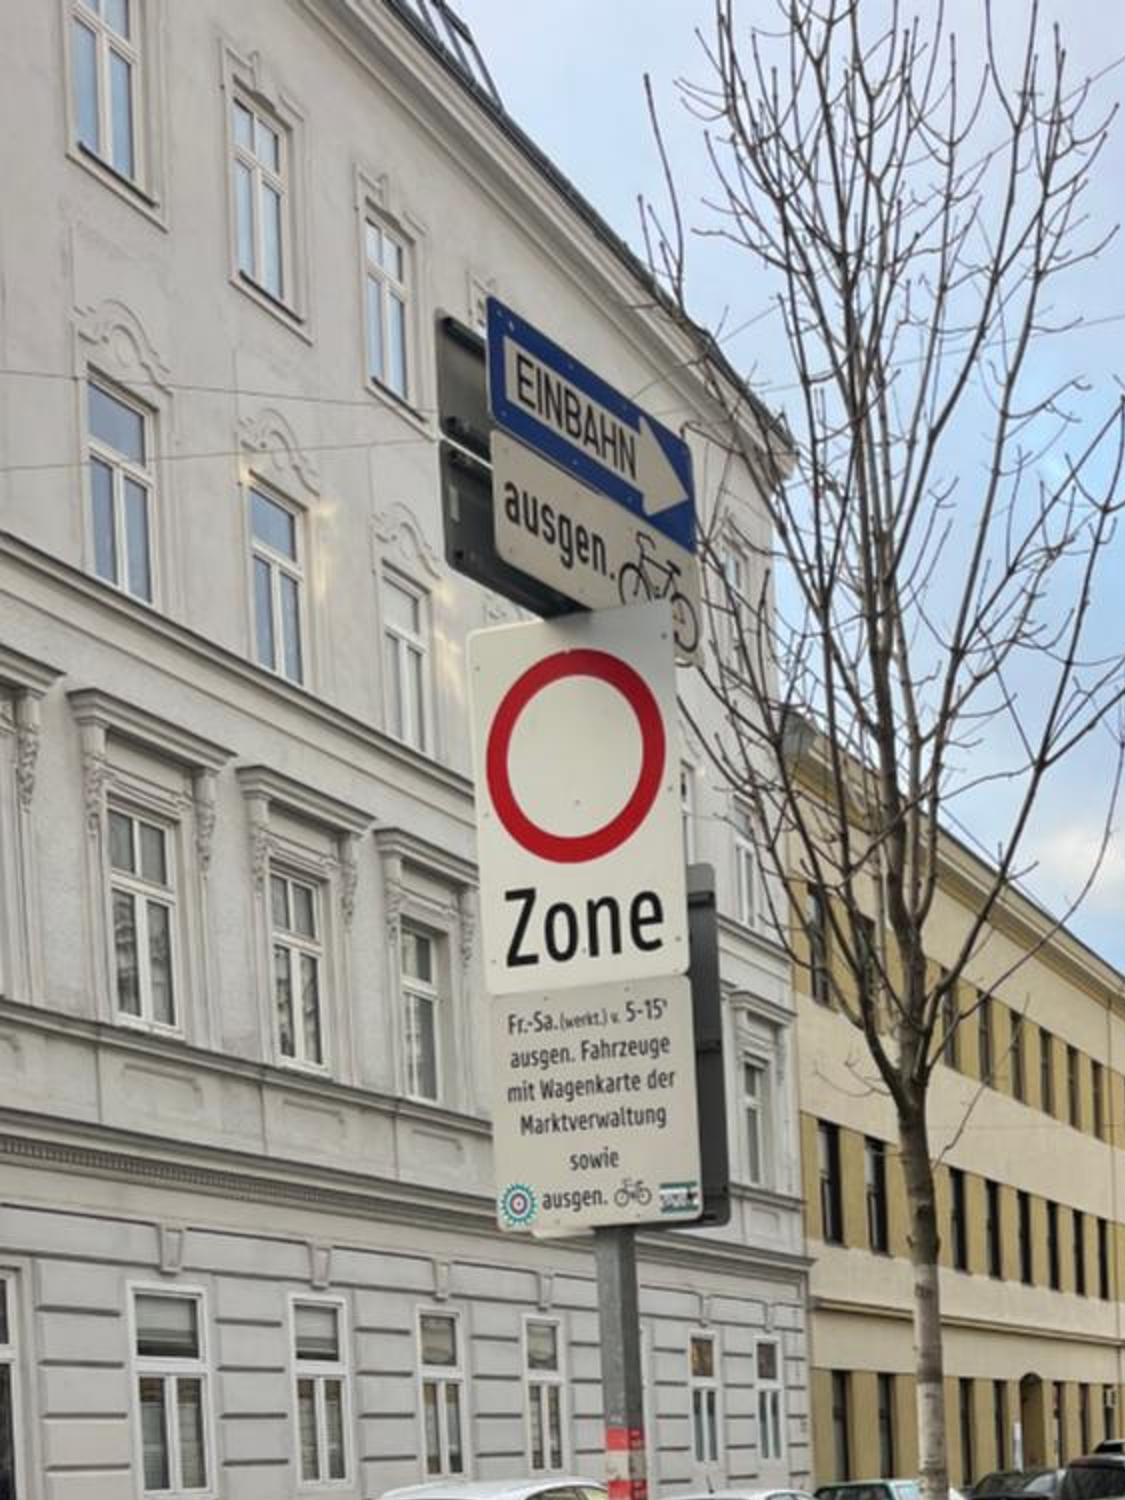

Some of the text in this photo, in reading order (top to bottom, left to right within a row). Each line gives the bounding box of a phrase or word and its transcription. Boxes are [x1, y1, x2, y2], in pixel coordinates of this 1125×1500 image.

[516, 353, 638, 480] EINBAHN
[504, 480, 616, 581] ausgen.
[504, 887, 664, 968] Zone
[507, 1011, 559, 1035] Fr.-Sa.
[510, 1036, 671, 1070] ausgen. Fahrzeuge
[507, 1069, 676, 1104] mit Wagenkarte der
[520, 1106, 667, 1136] Marktverwaltung
[569, 1146, 620, 1172] sowie
[542, 1188, 608, 1213] ausgen.
